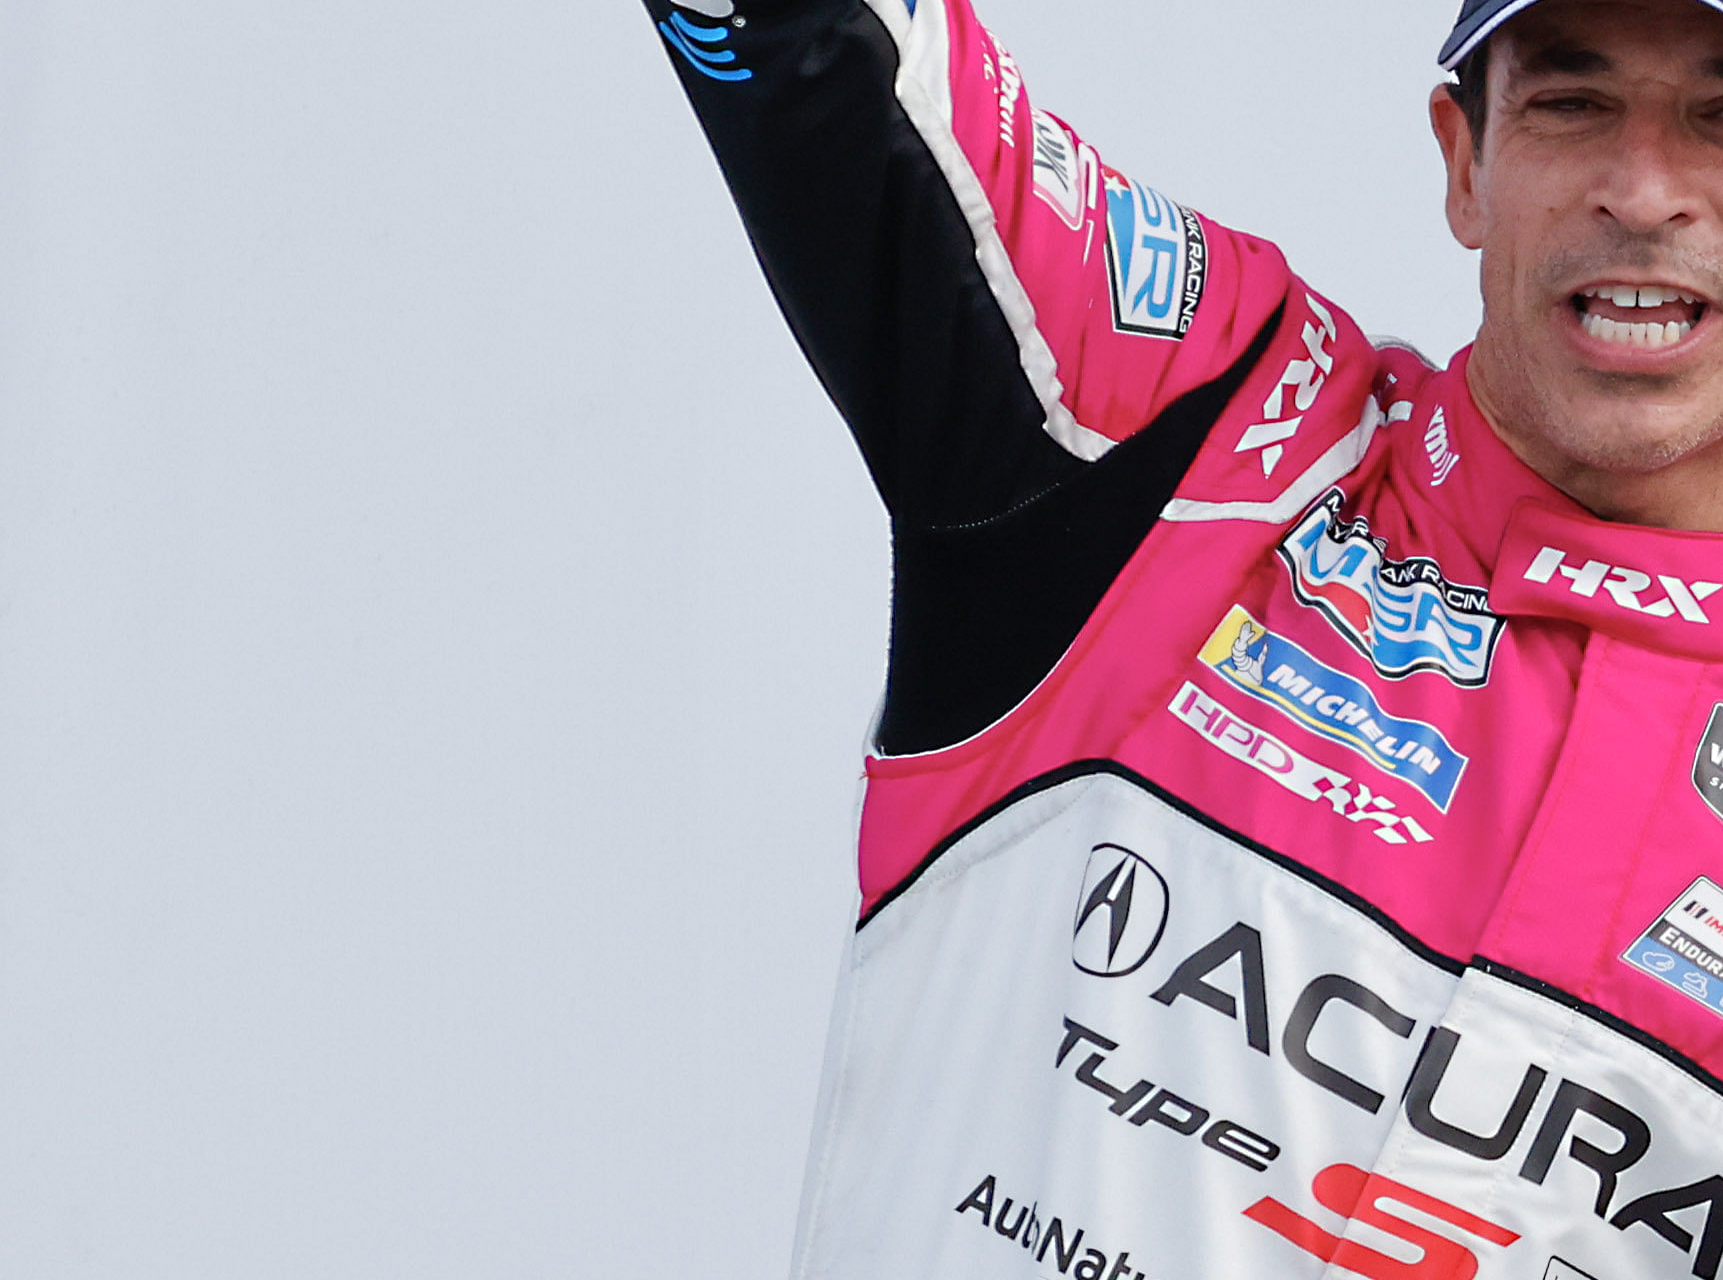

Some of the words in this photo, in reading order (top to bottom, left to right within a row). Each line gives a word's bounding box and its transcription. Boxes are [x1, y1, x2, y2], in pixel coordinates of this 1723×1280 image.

[1180, 241, 1203, 333] RACING
[1298, 518, 1482, 666] MSR
[1179, 689, 1294, 774] HPD
[1267, 664, 1442, 775] MICHELIN
